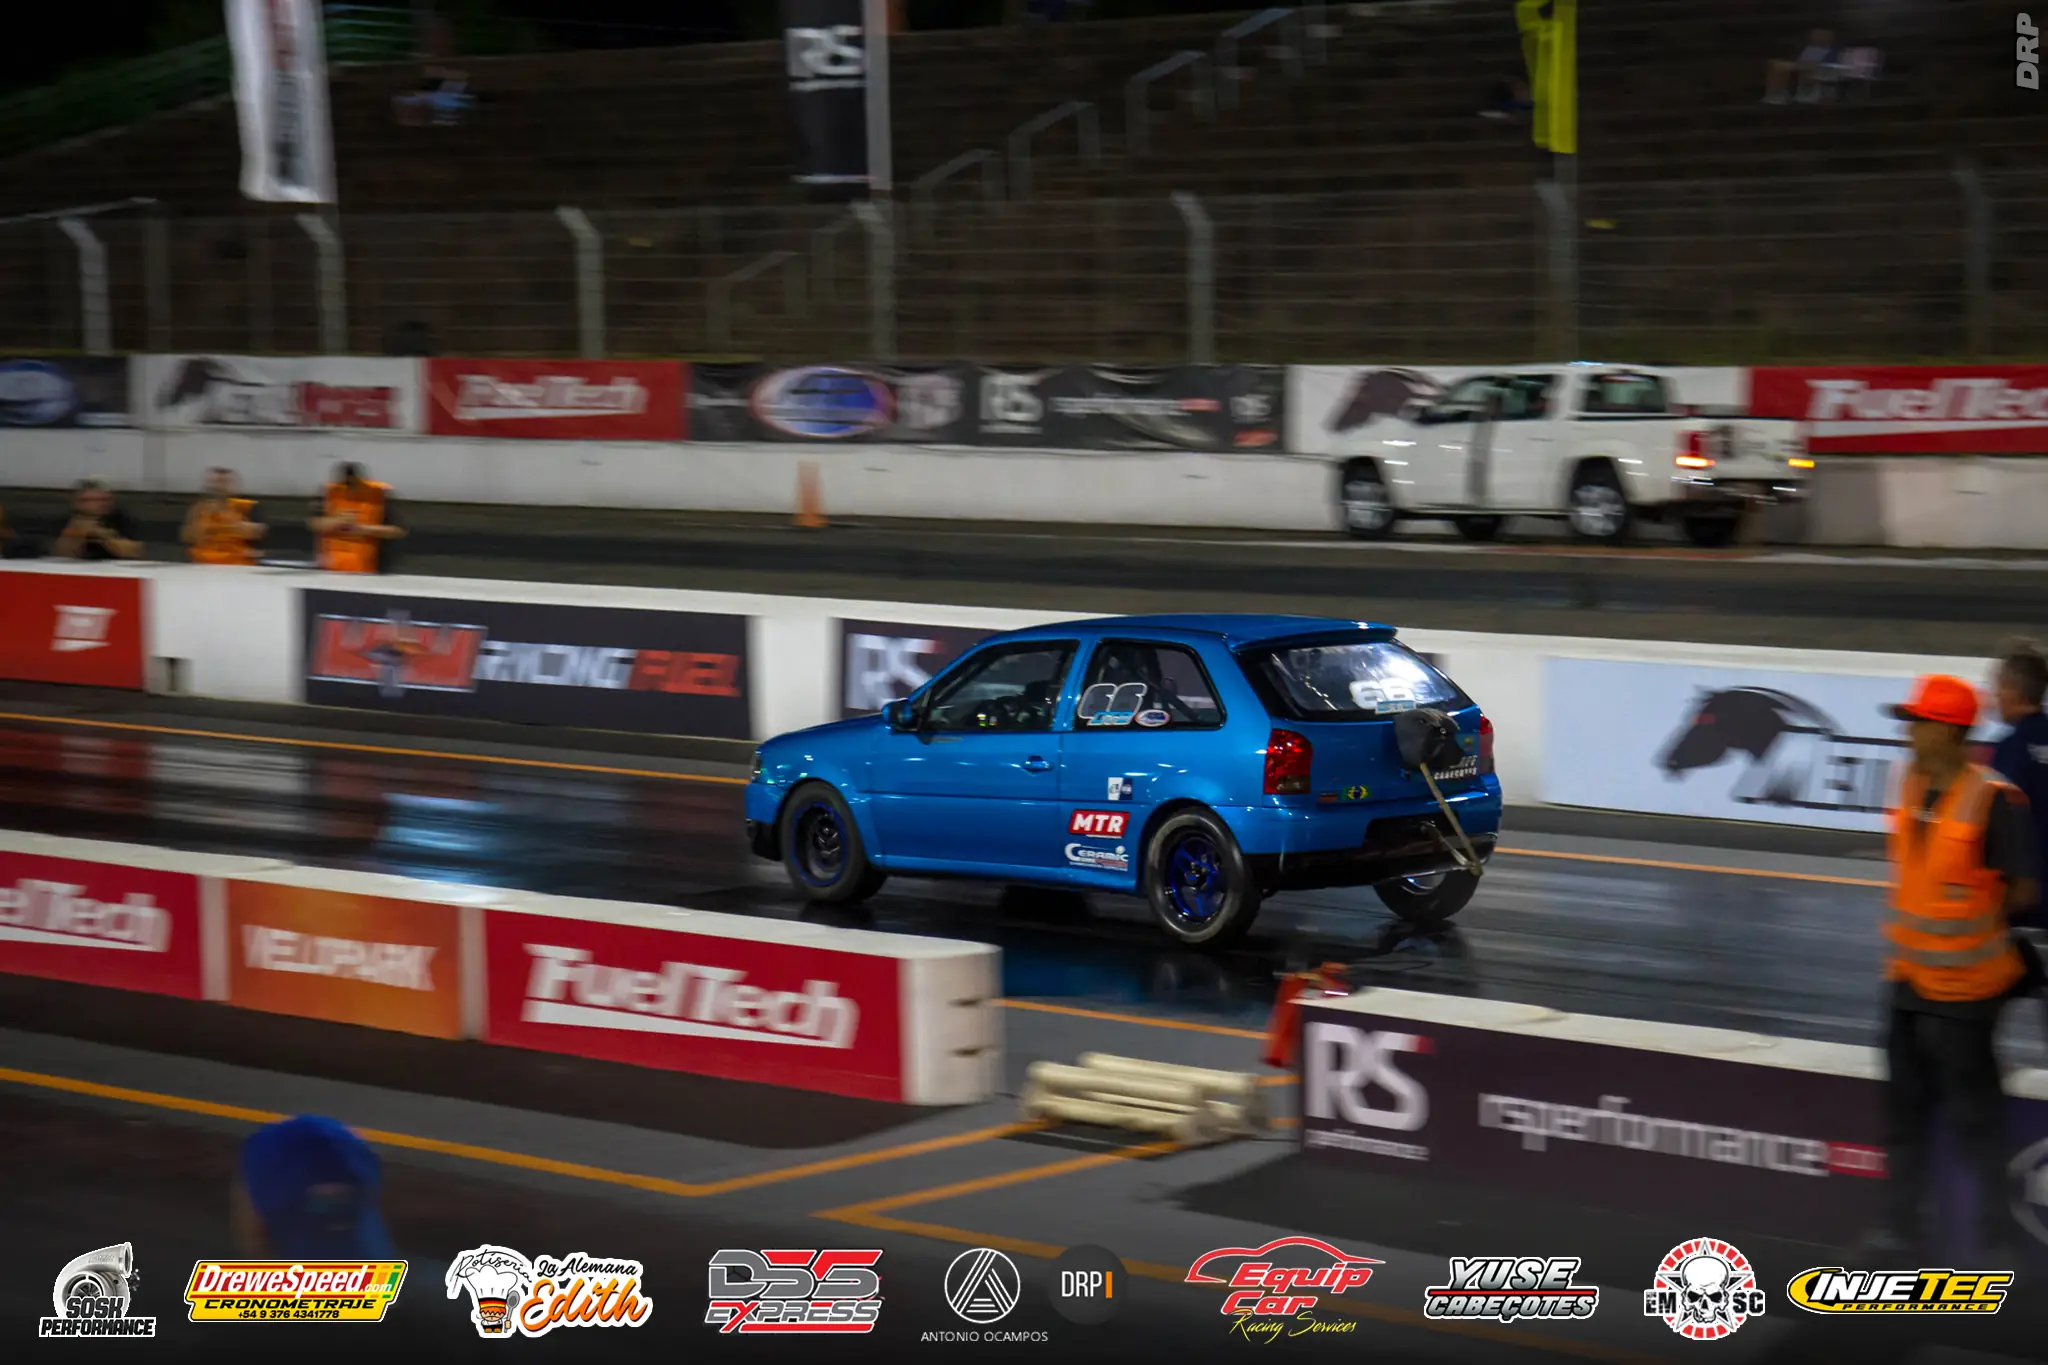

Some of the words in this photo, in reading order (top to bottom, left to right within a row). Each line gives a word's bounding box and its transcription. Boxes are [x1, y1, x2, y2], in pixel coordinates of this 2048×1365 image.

[1072, 813, 1124, 833] MTR
[521, 943, 860, 1049] FuelTech
[1305, 1021, 1432, 1132] RS
